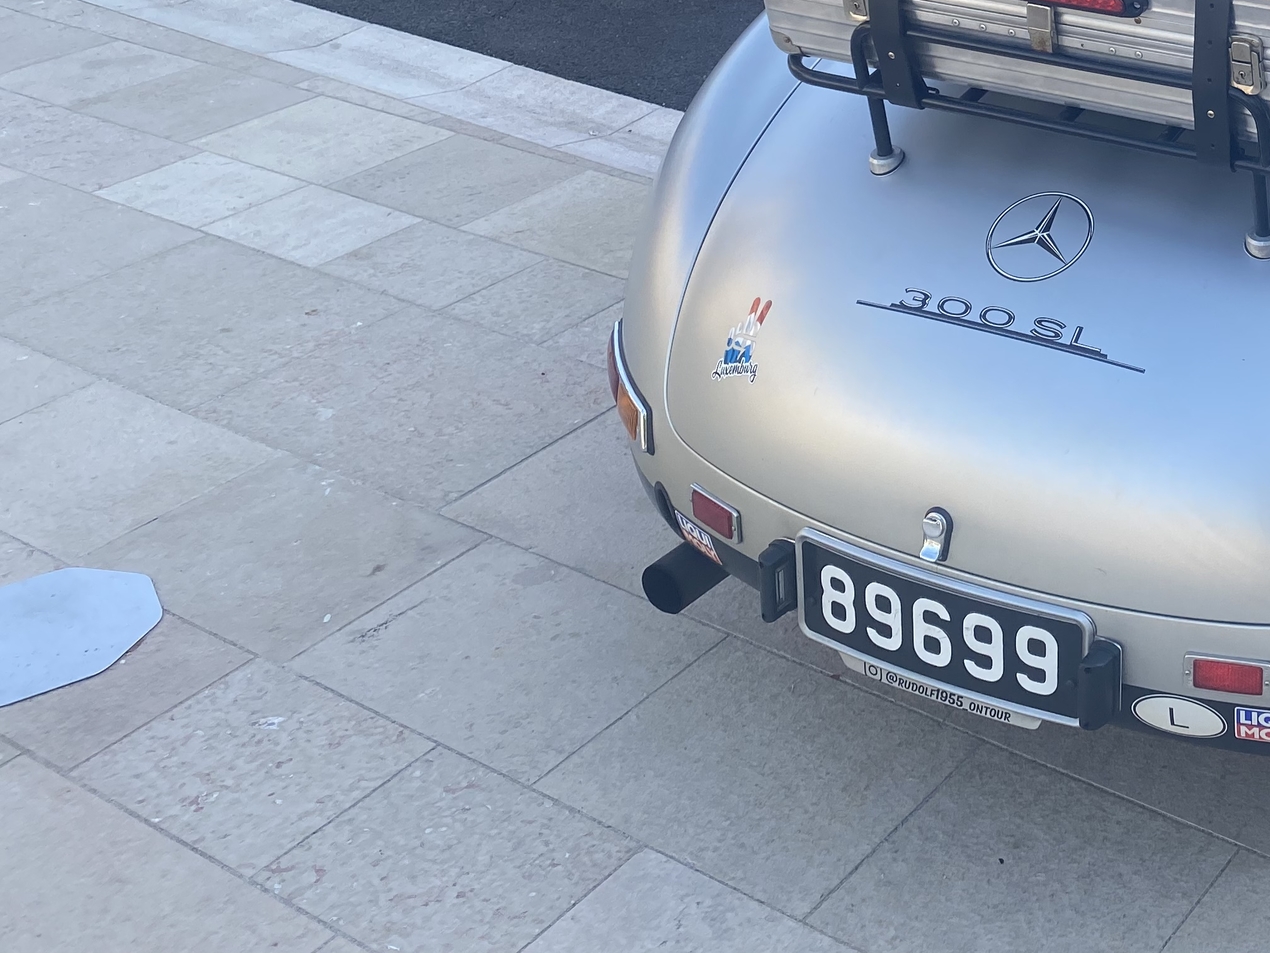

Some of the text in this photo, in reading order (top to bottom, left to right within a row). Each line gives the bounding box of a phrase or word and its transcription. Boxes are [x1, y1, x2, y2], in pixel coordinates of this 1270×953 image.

[899, 287, 1102, 353] 300 SL
[712, 357, 758, 383] Luxemburg
[677, 513, 712, 549] LIQUI
[820, 564, 1058, 696] 89699
[885, 671, 1011, 723] @RUDOLF1955_ONTOUR
[1169, 707, 1189, 729] L
